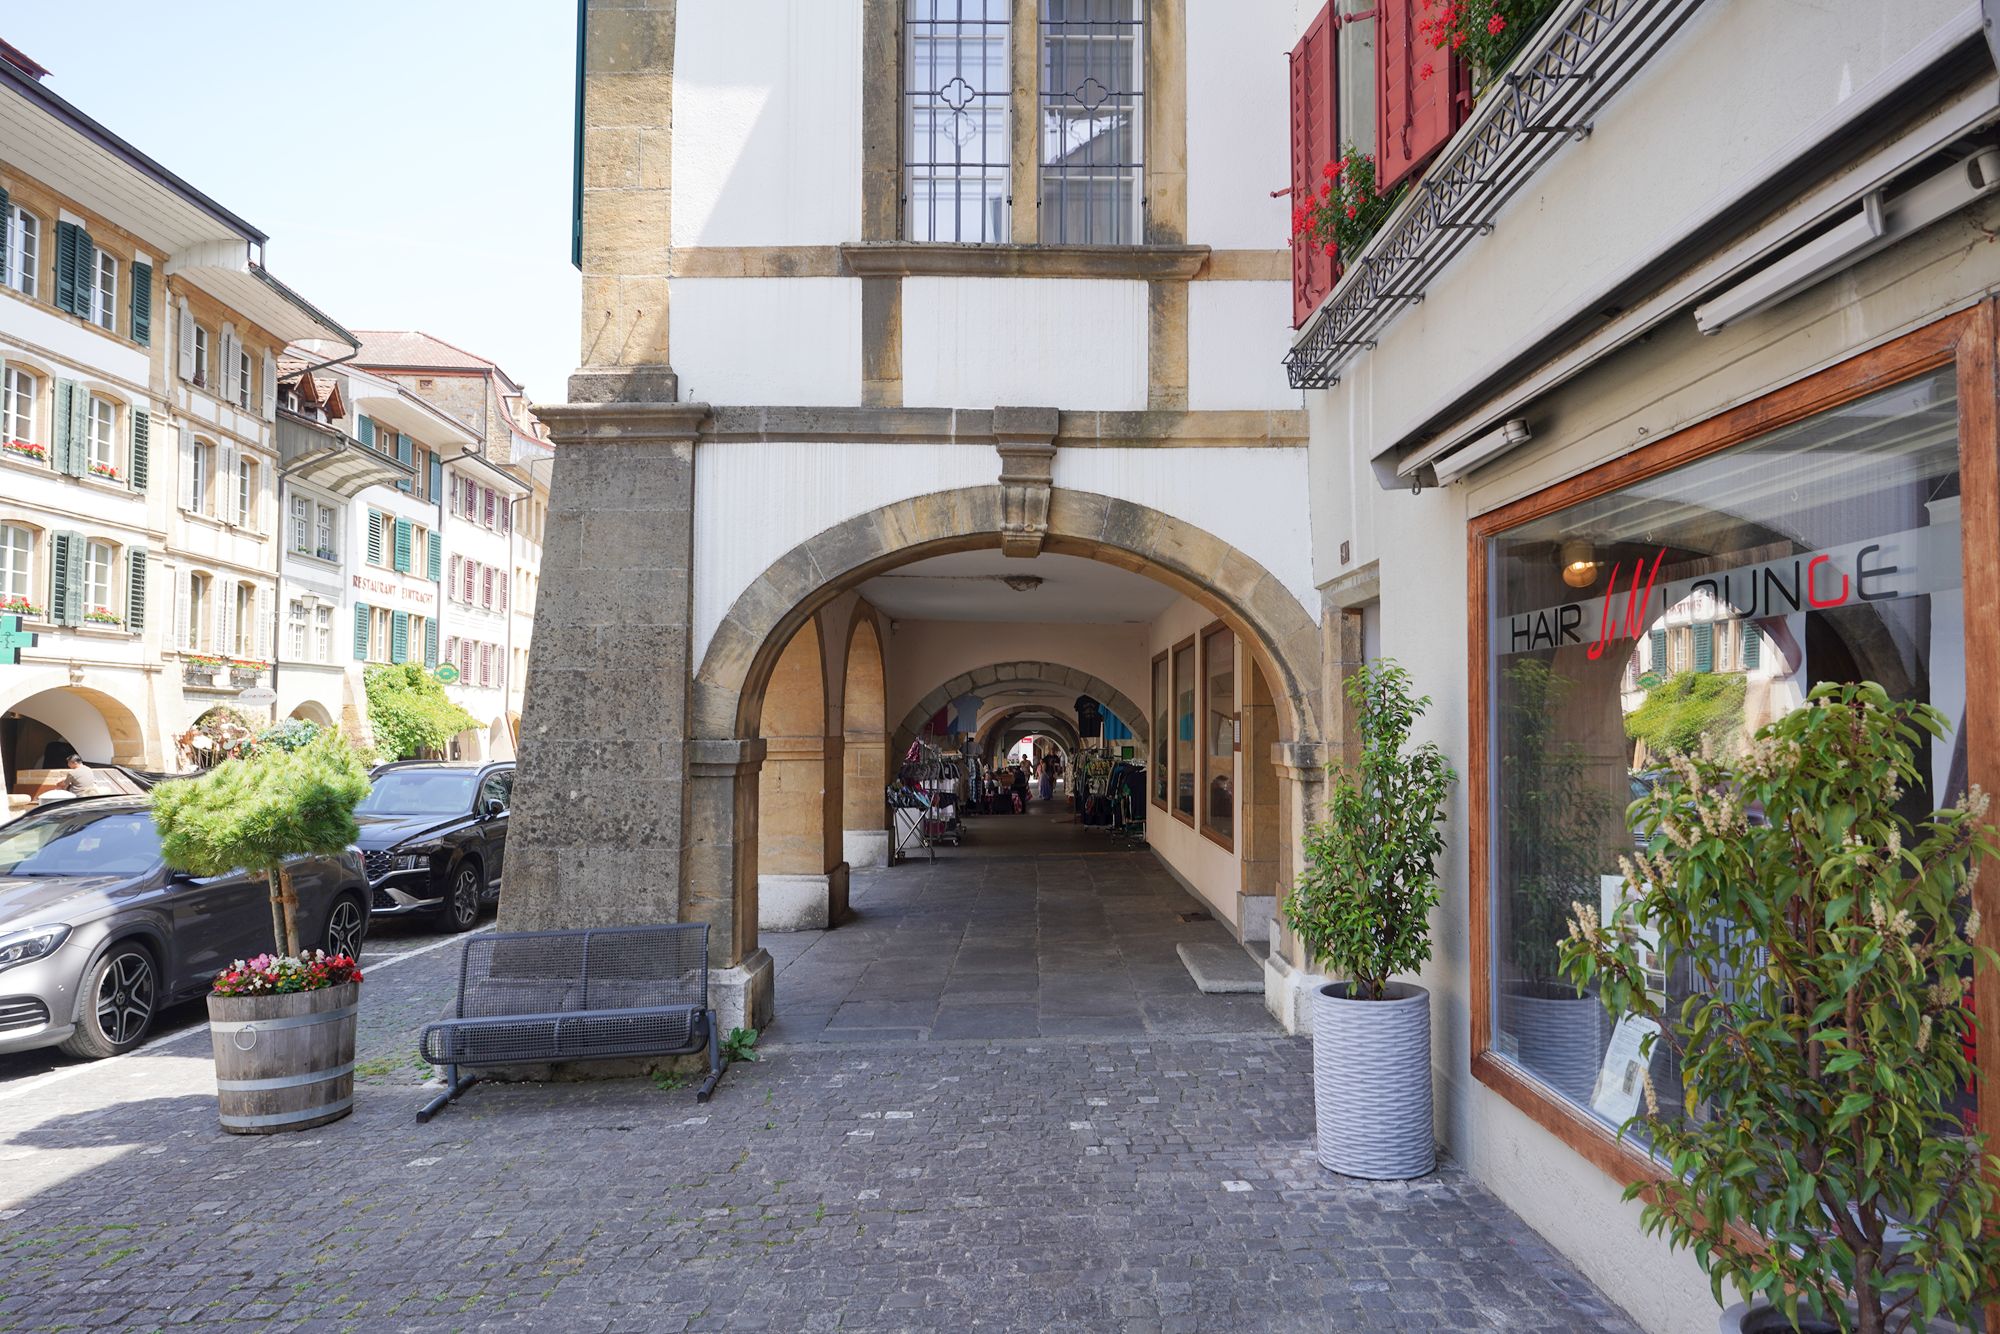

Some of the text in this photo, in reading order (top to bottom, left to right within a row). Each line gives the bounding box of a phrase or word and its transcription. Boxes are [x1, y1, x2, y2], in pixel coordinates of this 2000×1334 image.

[352, 575, 434, 605] RESTAURANT EINTRACHT
[1511, 603, 1582, 653] HAIR
